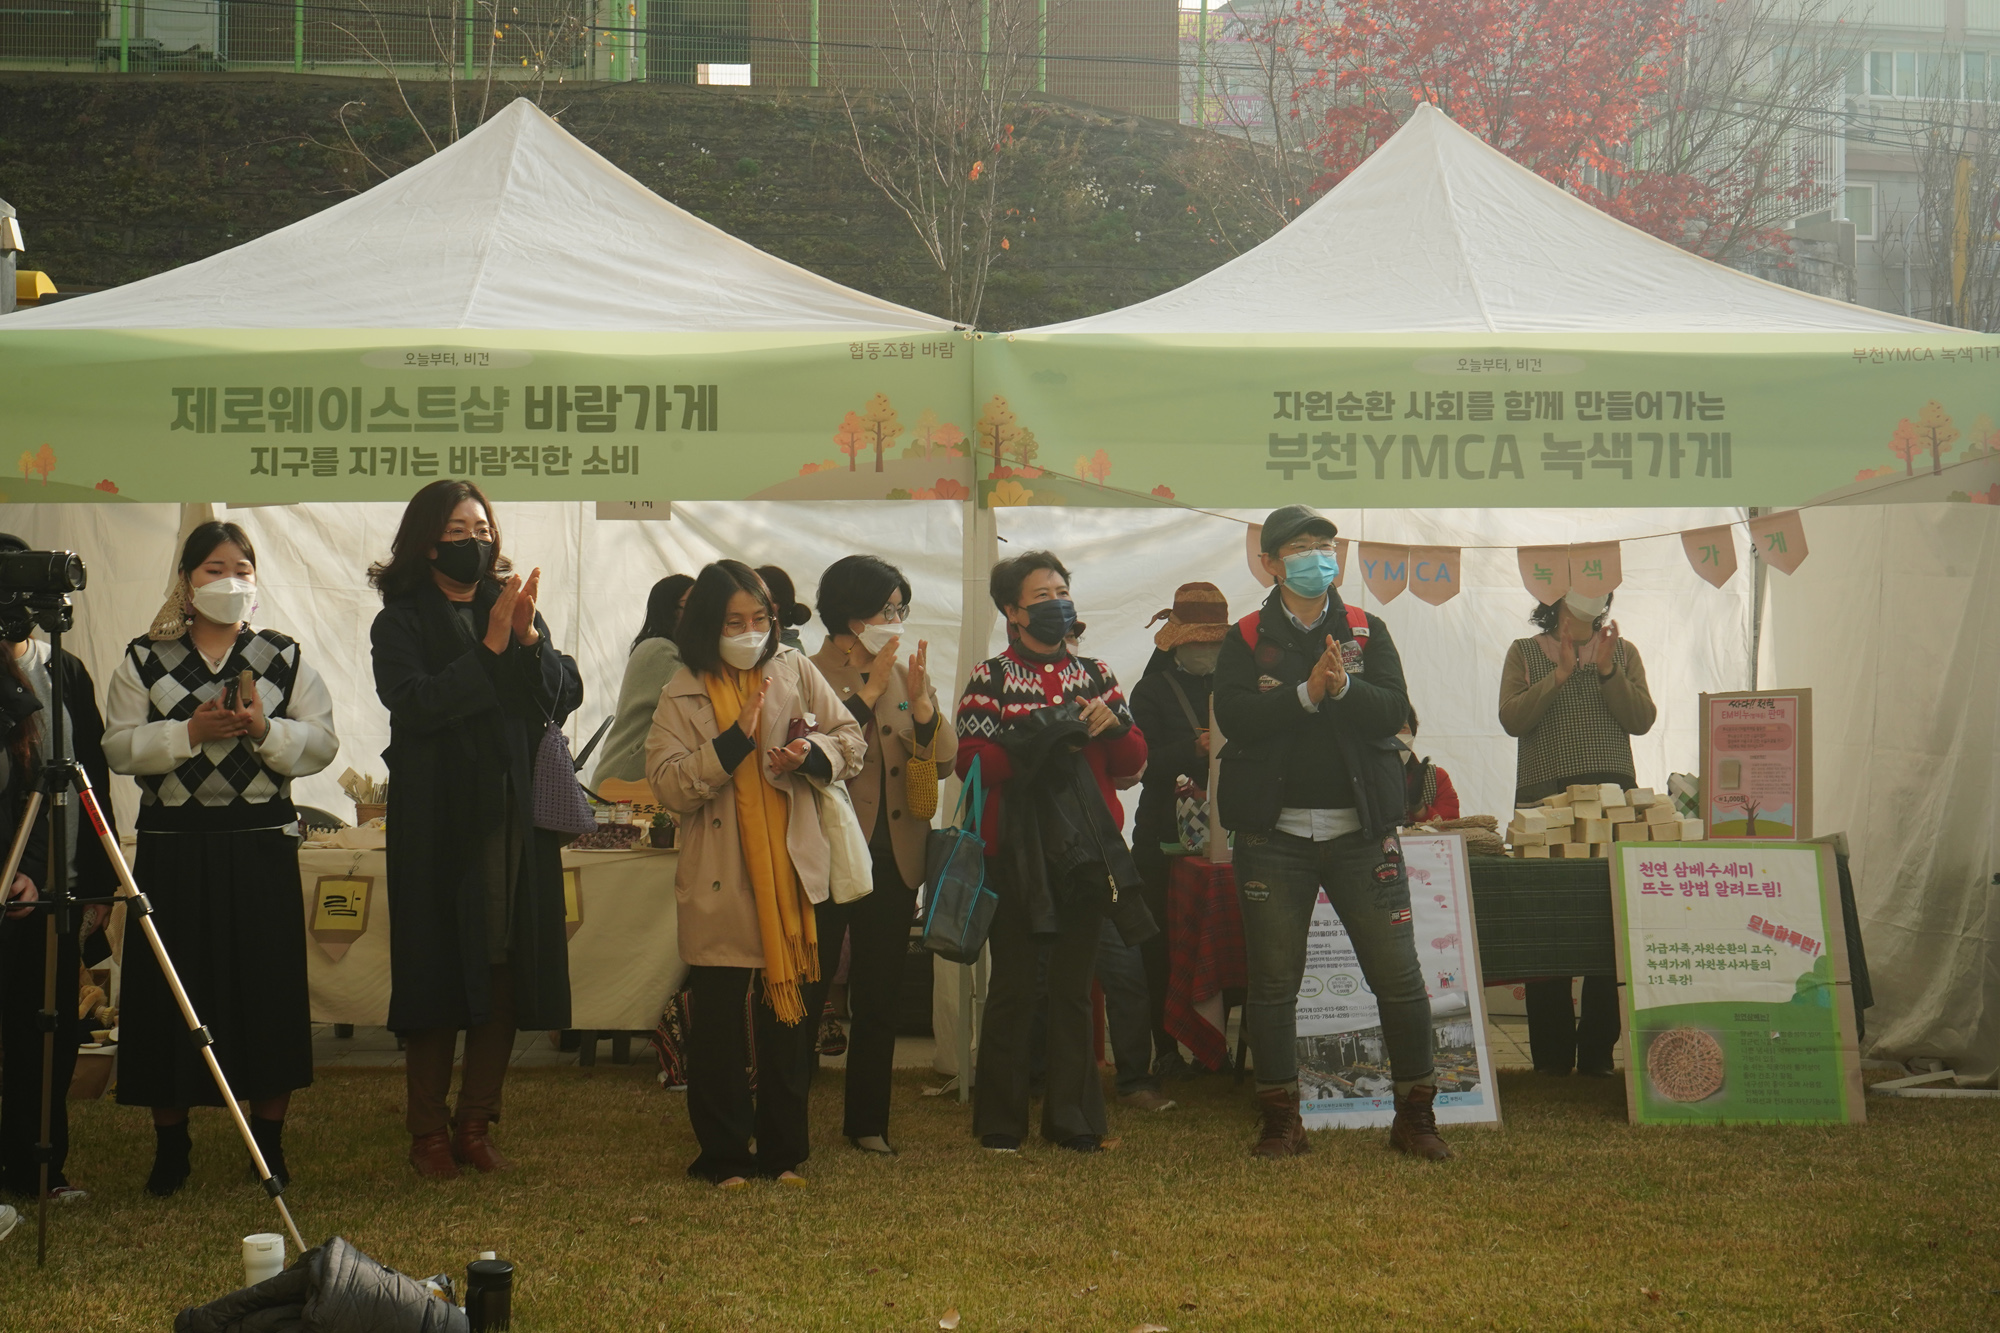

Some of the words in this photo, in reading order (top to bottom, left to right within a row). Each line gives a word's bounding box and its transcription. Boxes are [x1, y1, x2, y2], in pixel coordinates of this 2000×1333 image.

[849, 341, 916, 360] 협동조합
[921, 342, 955, 359] 바람
[1852, 347, 1935, 364] 부천YMCA
[404, 353, 458, 367] 오늘부터,
[464, 352, 489, 366] 비건
[1456, 358, 1511, 372] 오늘부터,
[1516, 358, 1542, 372] 비건
[171, 386, 509, 433] 제로웨이스트샵
[525, 385, 717, 433] 바람가게
[1273, 390, 1395, 421] 자원순환
[1404, 390, 1495, 421] 사회를
[1504, 390, 1563, 421] 함께
[1575, 391, 1725, 421] 만들어가는
[250, 447, 339, 477] 지구를
[349, 447, 439, 476] 지키는
[449, 445, 572, 476] 바람직한
[581, 445, 639, 475] 소비
[1266, 432, 1525, 480] 부천YMCA
[1540, 432, 1732, 480] 녹색가게
[1363, 560, 1451, 583] YMCA
[1768, 709, 1785, 719] 판매
[1639, 862, 1668, 877] 천연
[1673, 862, 1754, 878] 삼베수세미
[1641, 882, 1675, 897] 뜨는
[1679, 881, 1710, 897] 방법
[1715, 881, 1782, 898] 알려드림!
[323, 890, 361, 917] 람
[1746, 914, 1822, 956] 오늘하루만!
[1750, 945, 1777, 956] 고수,
[1647, 959, 1691, 970] 녹색가게
[1695, 959, 1771, 971] 자원봉사자들의
[1648, 975, 1664, 985] 1:1
[1667, 975, 1693, 986] 특강!
